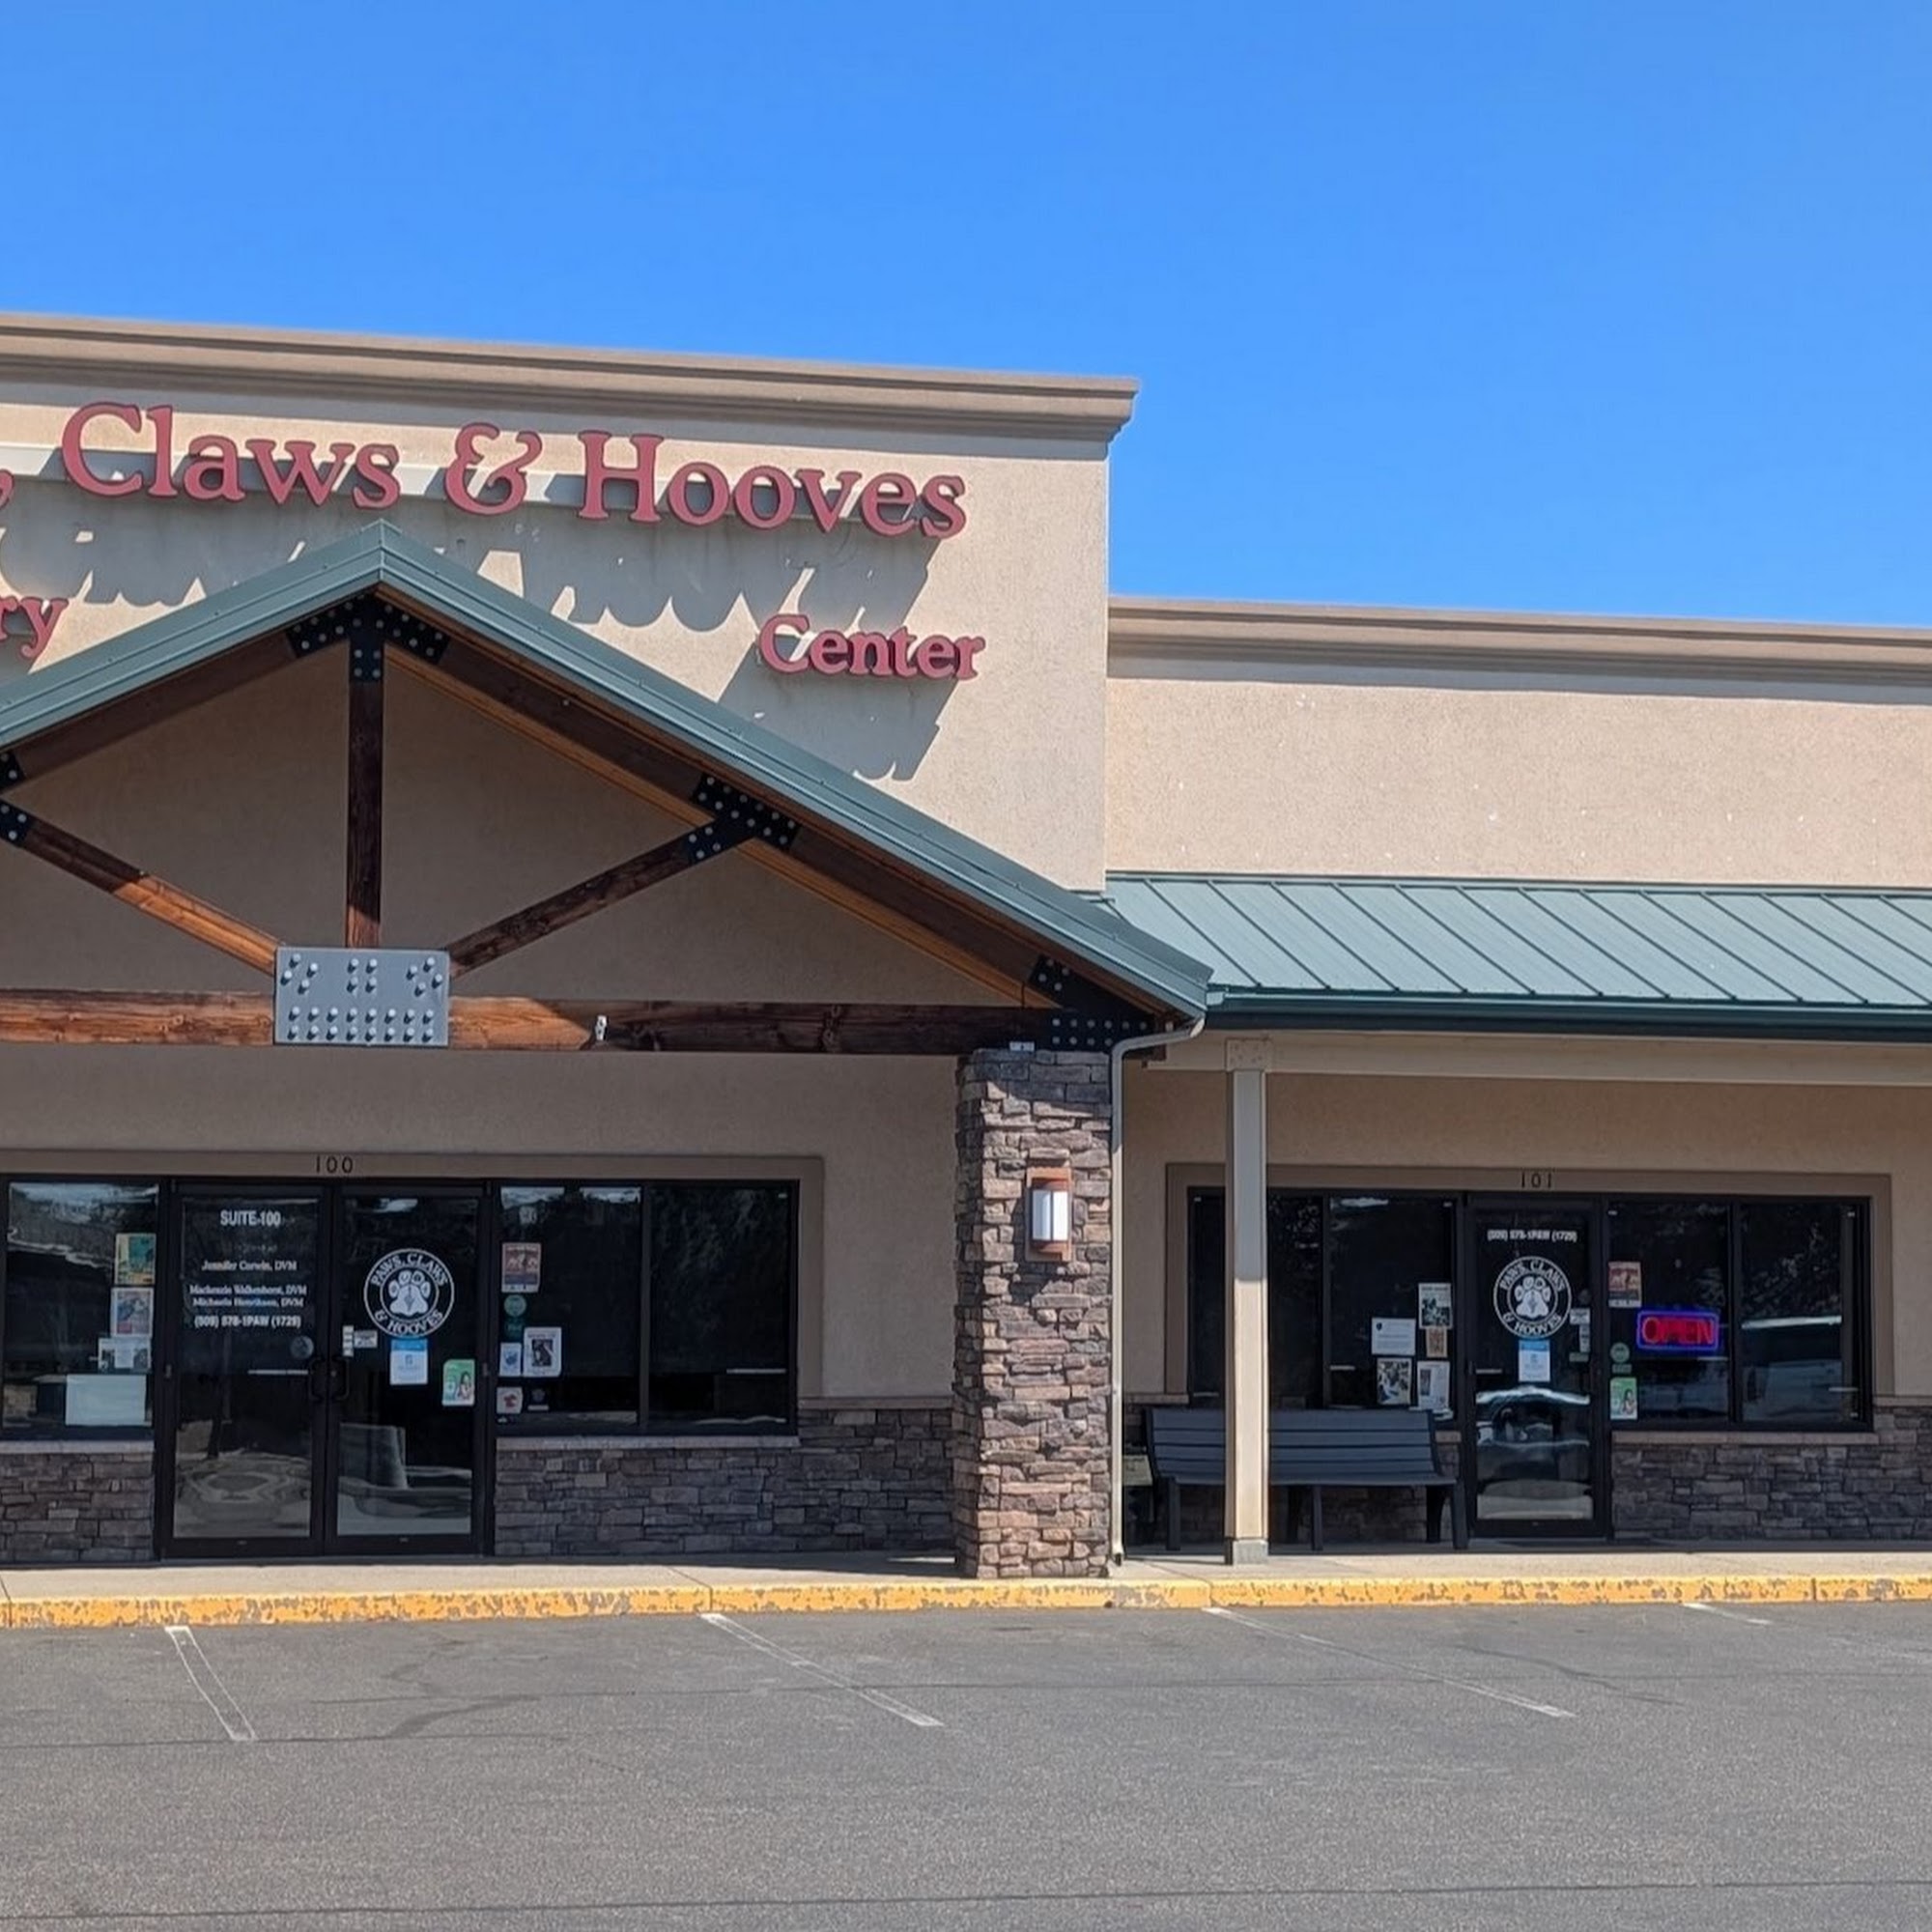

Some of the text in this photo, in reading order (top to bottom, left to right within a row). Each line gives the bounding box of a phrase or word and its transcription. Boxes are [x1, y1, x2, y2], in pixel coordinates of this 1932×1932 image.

[61, 401, 967, 539] Claws & Hooves
[759, 613, 986, 680] Center
[316, 1155, 354, 1174] 100
[1521, 1171, 1551, 1188] 101
[407, 1253, 448, 1287] CLAWS
[387, 1310, 444, 1334] HOOVES
[1641, 1316, 1715, 1346] OPEN
